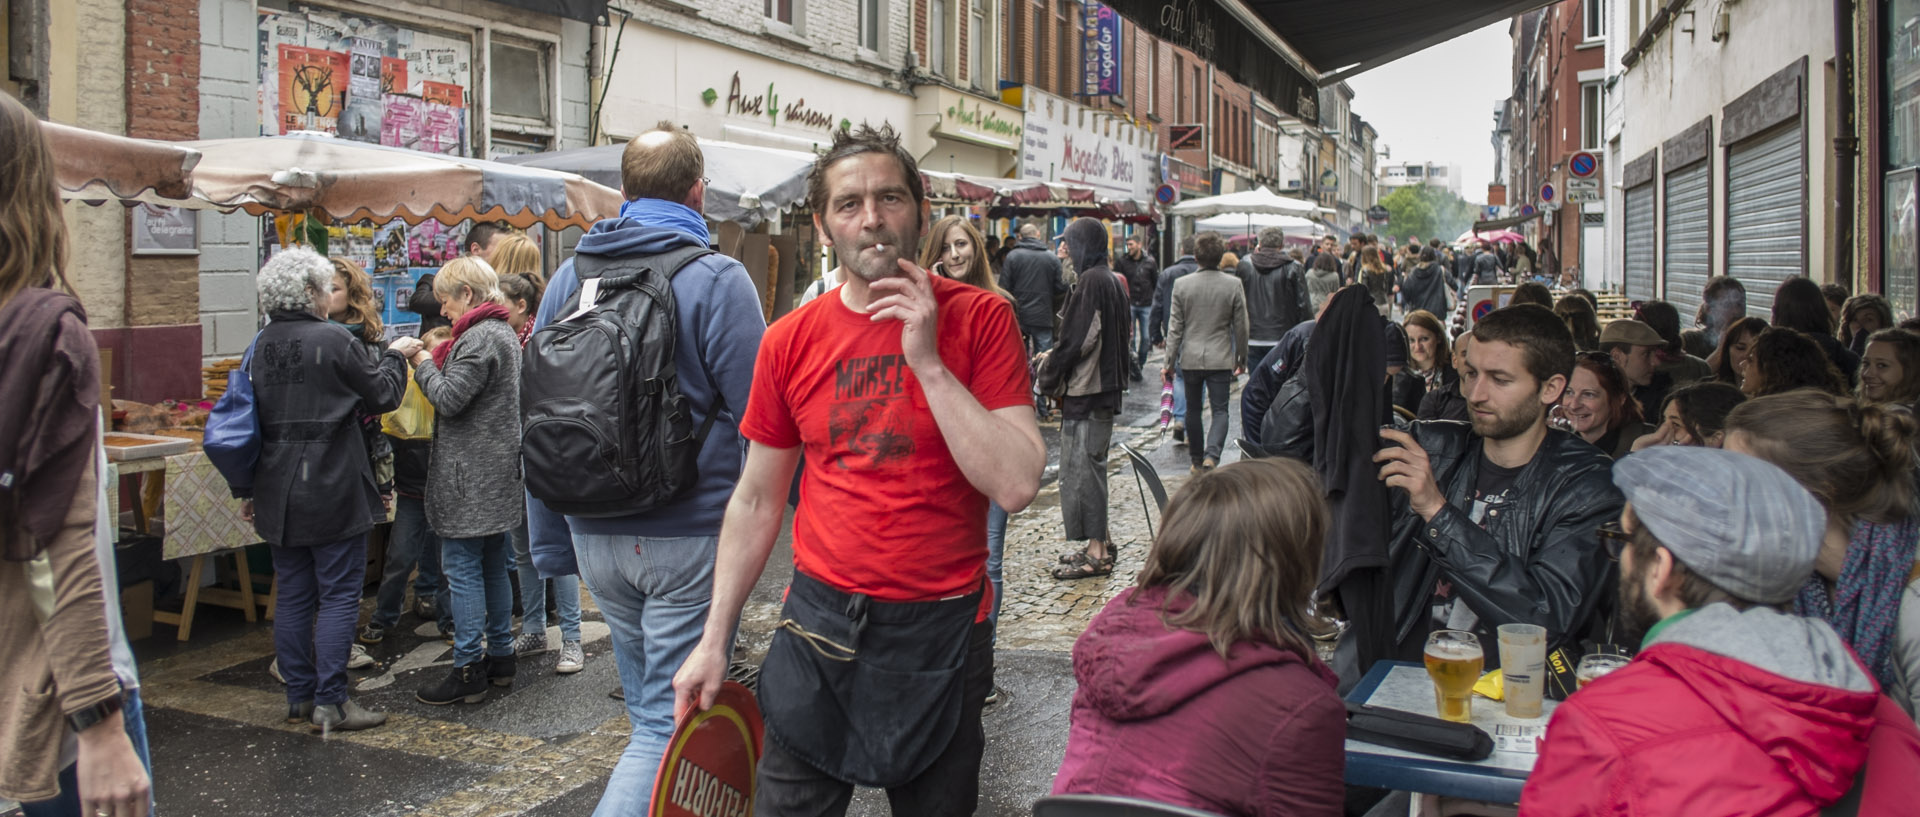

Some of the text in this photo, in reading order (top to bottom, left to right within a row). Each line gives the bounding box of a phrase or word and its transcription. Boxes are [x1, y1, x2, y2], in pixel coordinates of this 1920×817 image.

[1097, 26, 1116, 93] Mogador
[727, 70, 833, 131] Aux 4 saisons
[956, 96, 975, 126] Aux
[984, 110, 1013, 136] saisons
[1061, 133, 1108, 183] Mogador
[1112, 146, 1133, 183] Déco
[1568, 192, 1597, 200] RAEL
[1549, 650, 1567, 674] ikon
